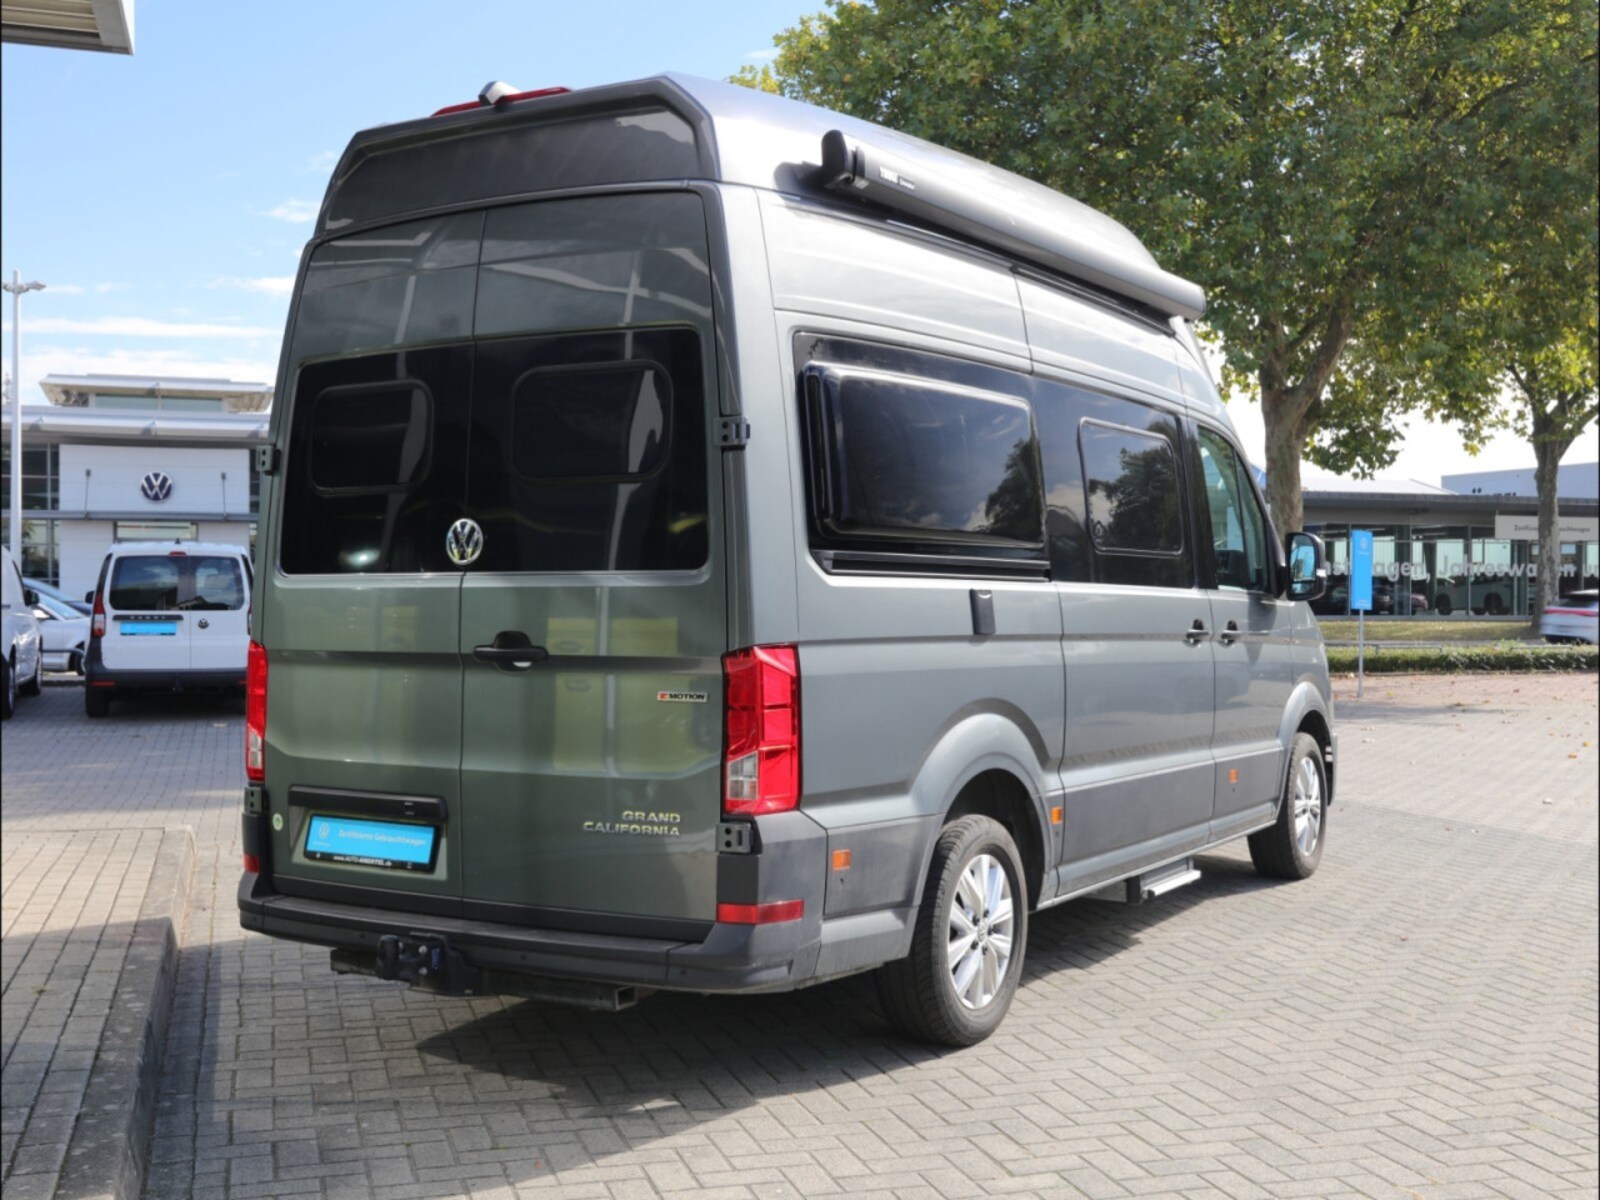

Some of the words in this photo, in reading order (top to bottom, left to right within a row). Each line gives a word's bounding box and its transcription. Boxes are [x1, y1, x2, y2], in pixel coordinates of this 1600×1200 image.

[446, 518, 484, 565] VW
[622, 810, 681, 823] GRAND
[582, 821, 681, 836] CALIFORNIA
